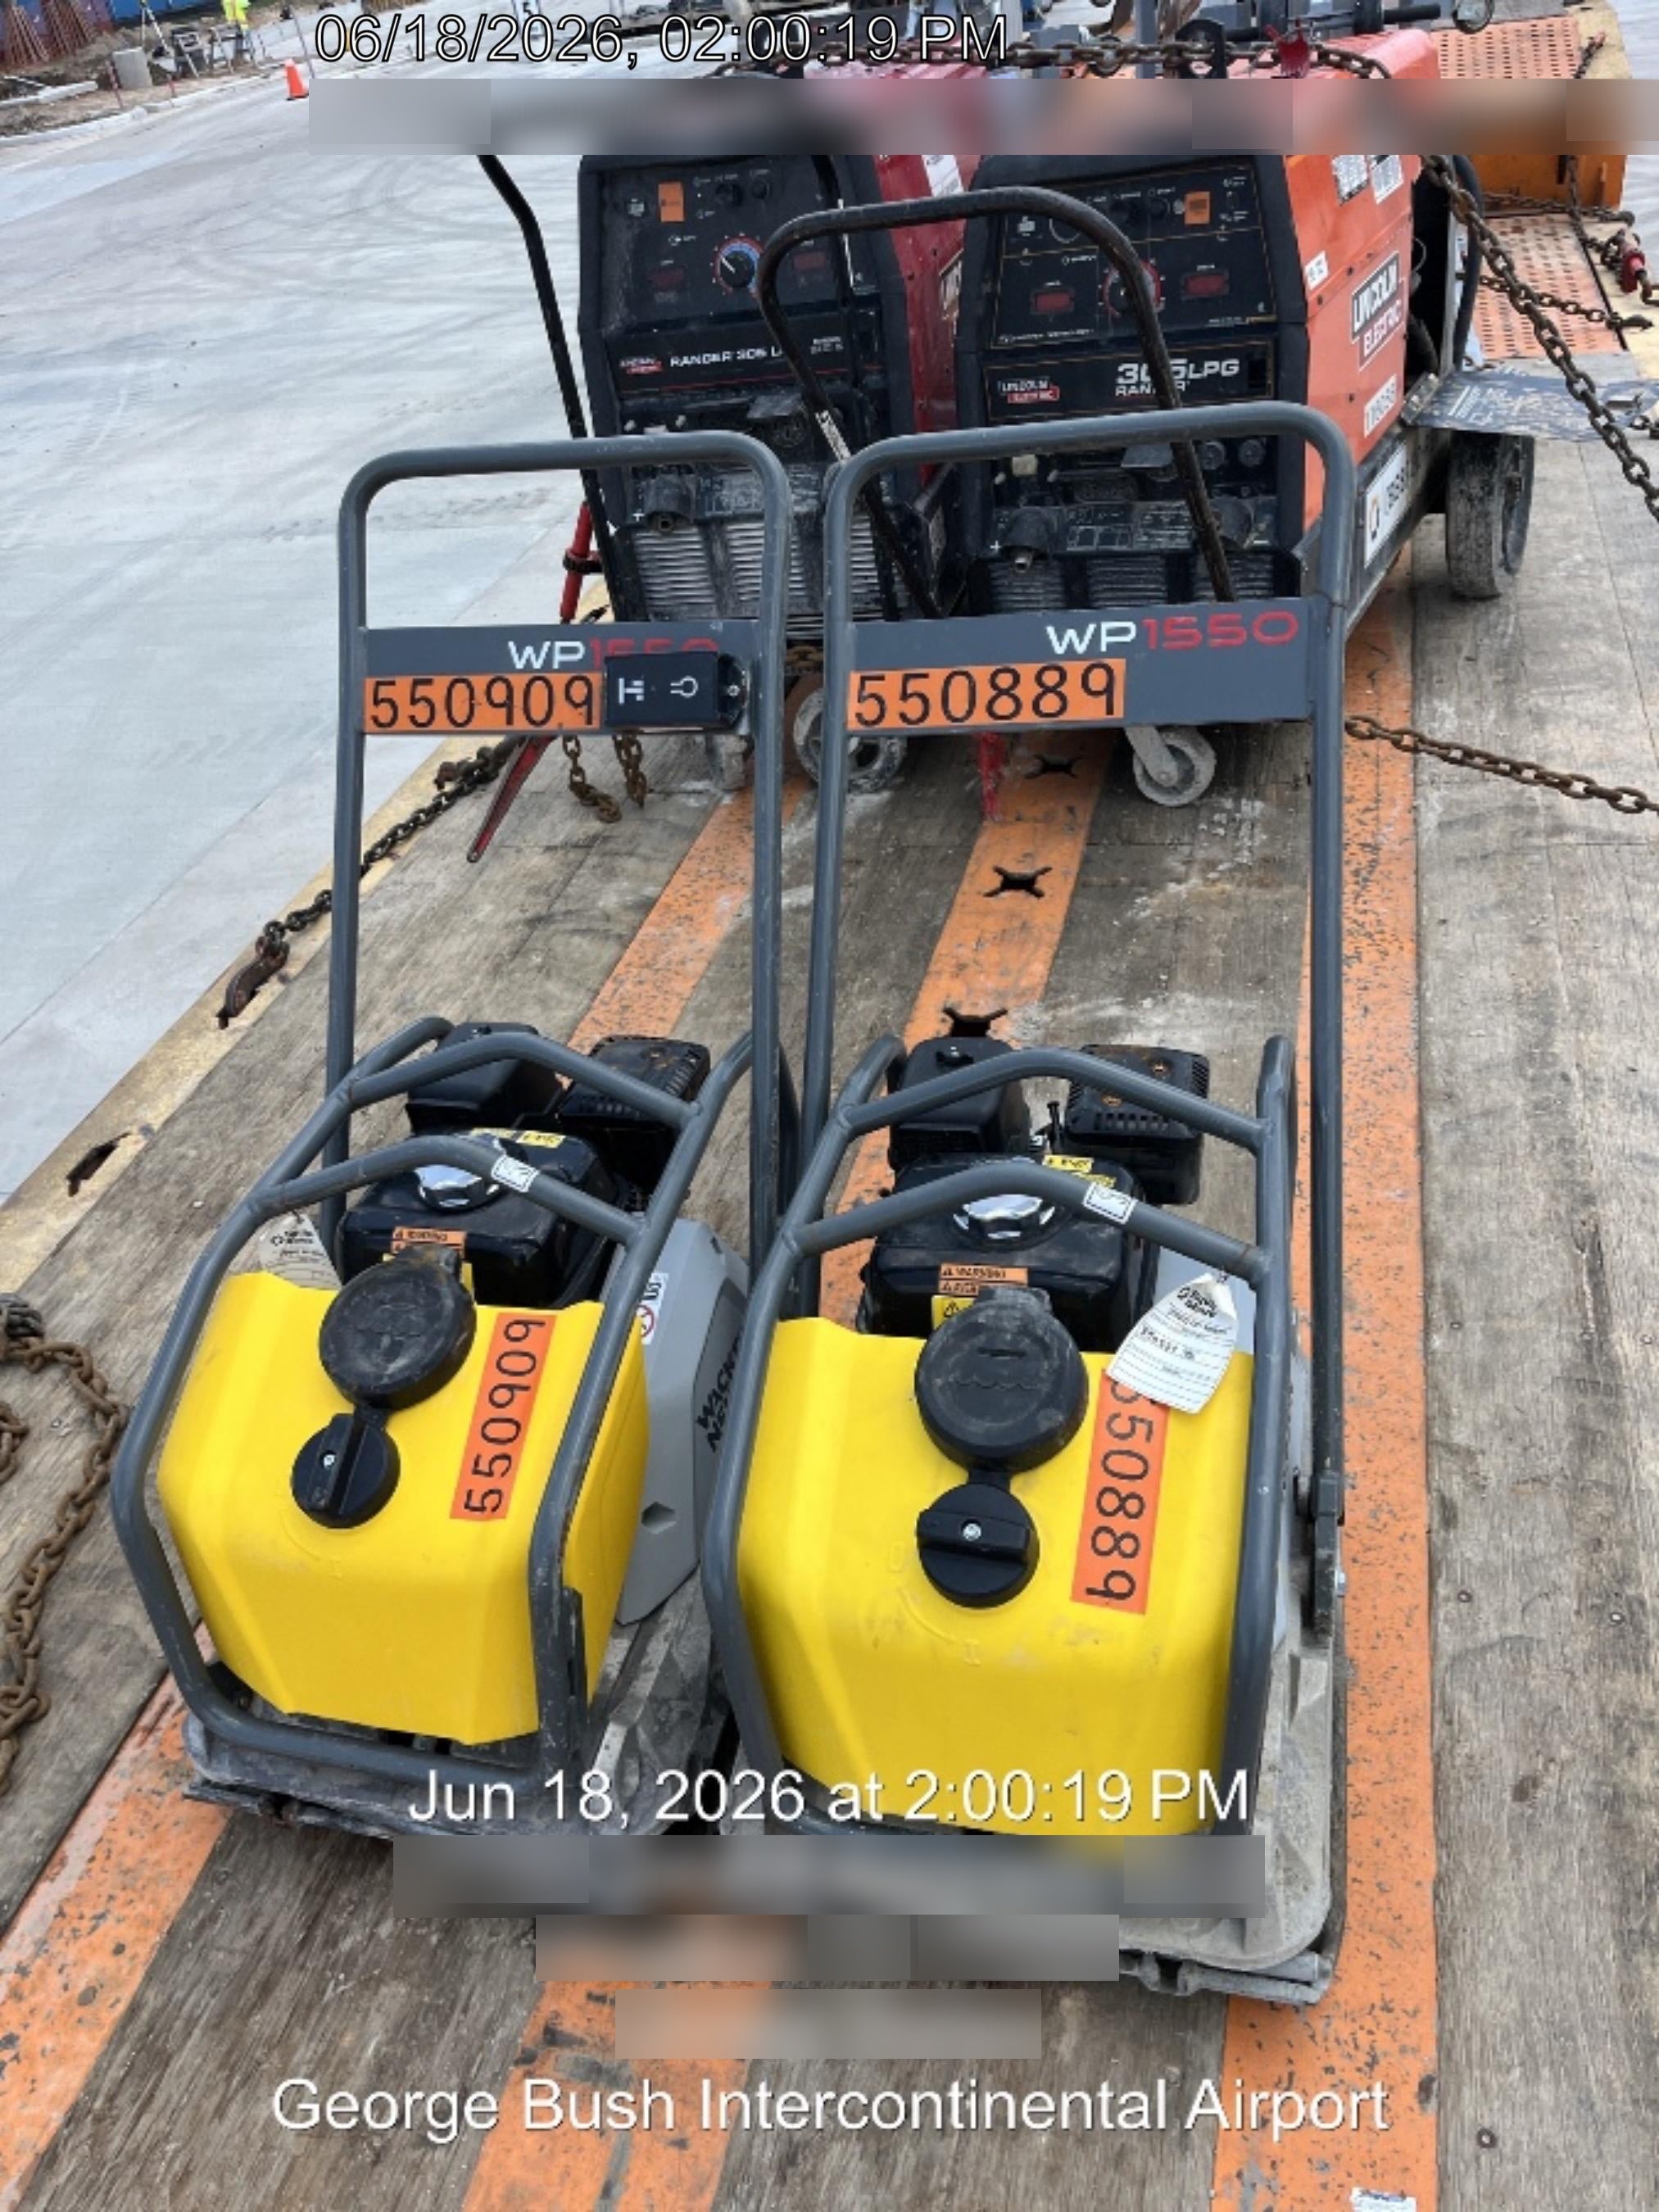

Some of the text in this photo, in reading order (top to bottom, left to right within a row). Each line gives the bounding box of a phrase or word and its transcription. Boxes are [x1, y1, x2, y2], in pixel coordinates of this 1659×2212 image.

[1115, 379, 1186, 397] RANR
[1046, 610, 1299, 655] WP1550
[370, 675, 595, 728] 550909
[854, 662, 1117, 728] 550889
[463, 1317, 546, 1514] 550909
